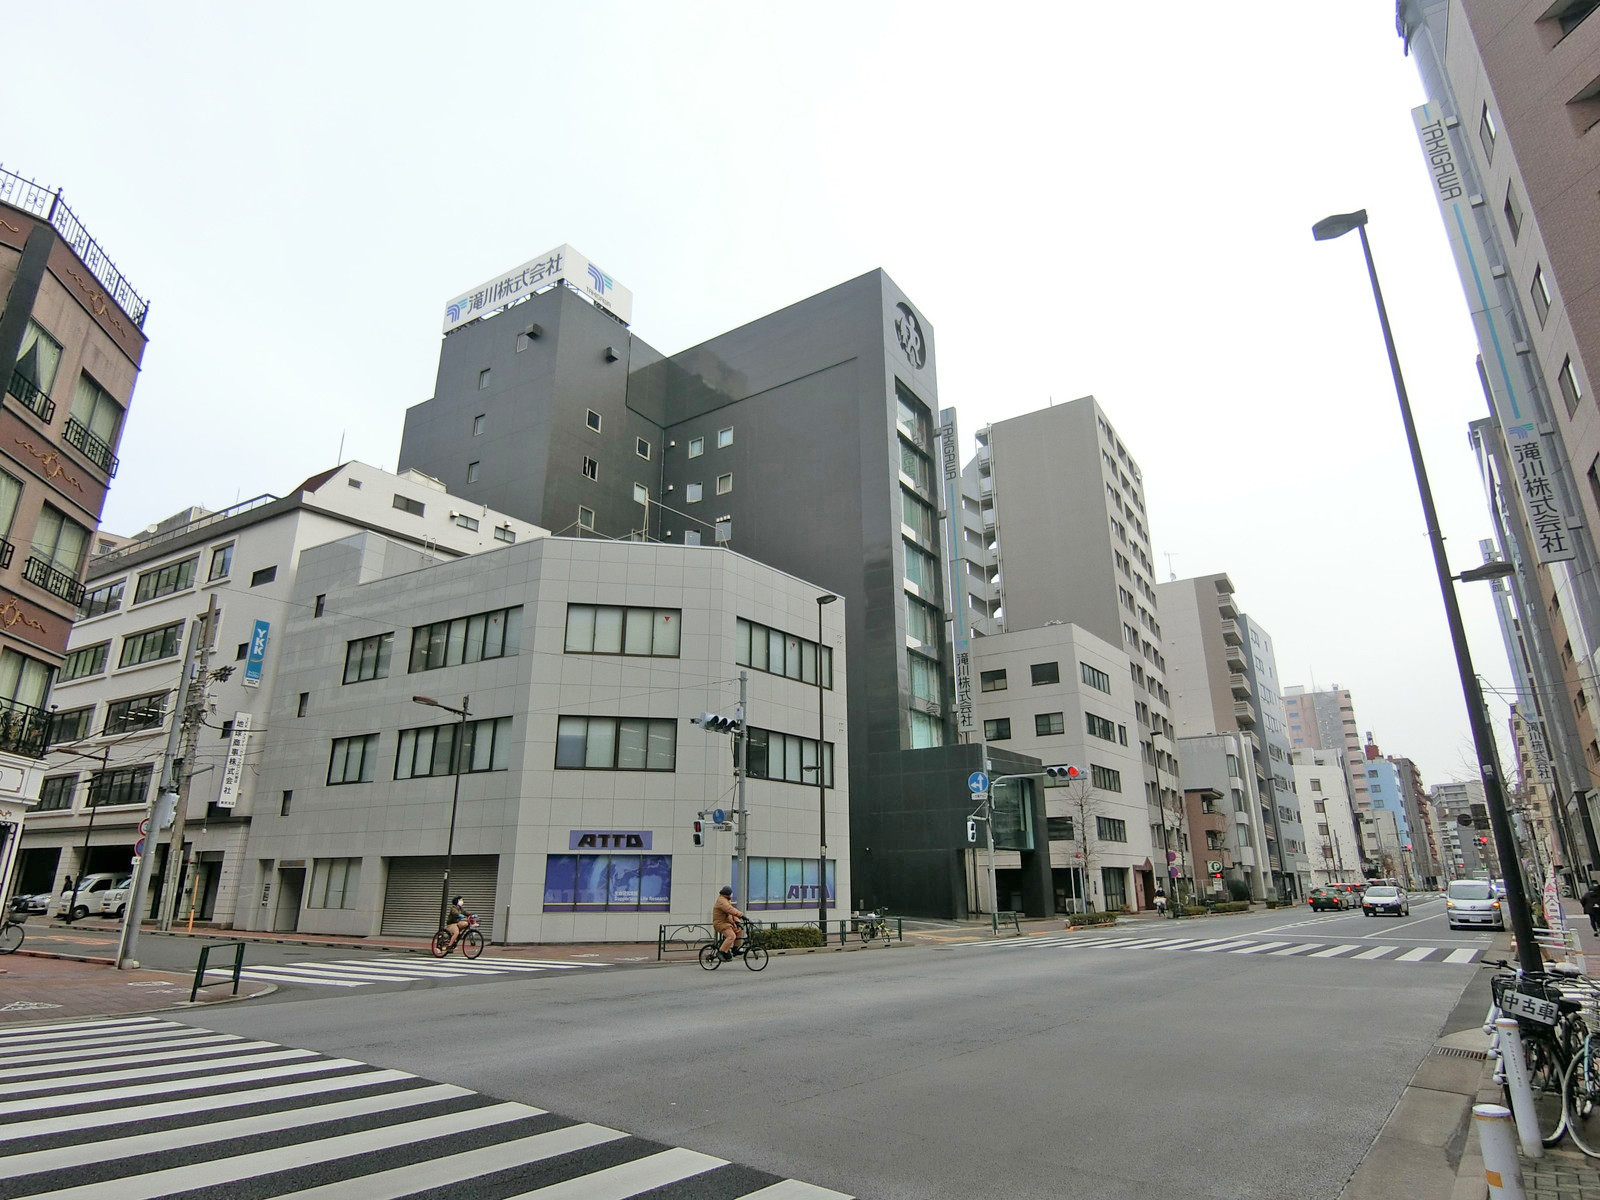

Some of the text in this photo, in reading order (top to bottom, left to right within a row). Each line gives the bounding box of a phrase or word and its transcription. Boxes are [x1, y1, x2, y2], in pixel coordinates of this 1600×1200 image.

[1421, 119, 1463, 202] TAKIGAWA
[466, 253, 563, 315] 滝川株式会社
[942, 420, 957, 481] TAKIGAWA
[1513, 442, 1569, 554] 滝川株式会社
[253, 628, 267, 656] YKK
[956, 652, 974, 727] 滝川株式会社
[223, 719, 245, 795] 地球商事株式会社
[1502, 992, 1556, 1021] 中古車
